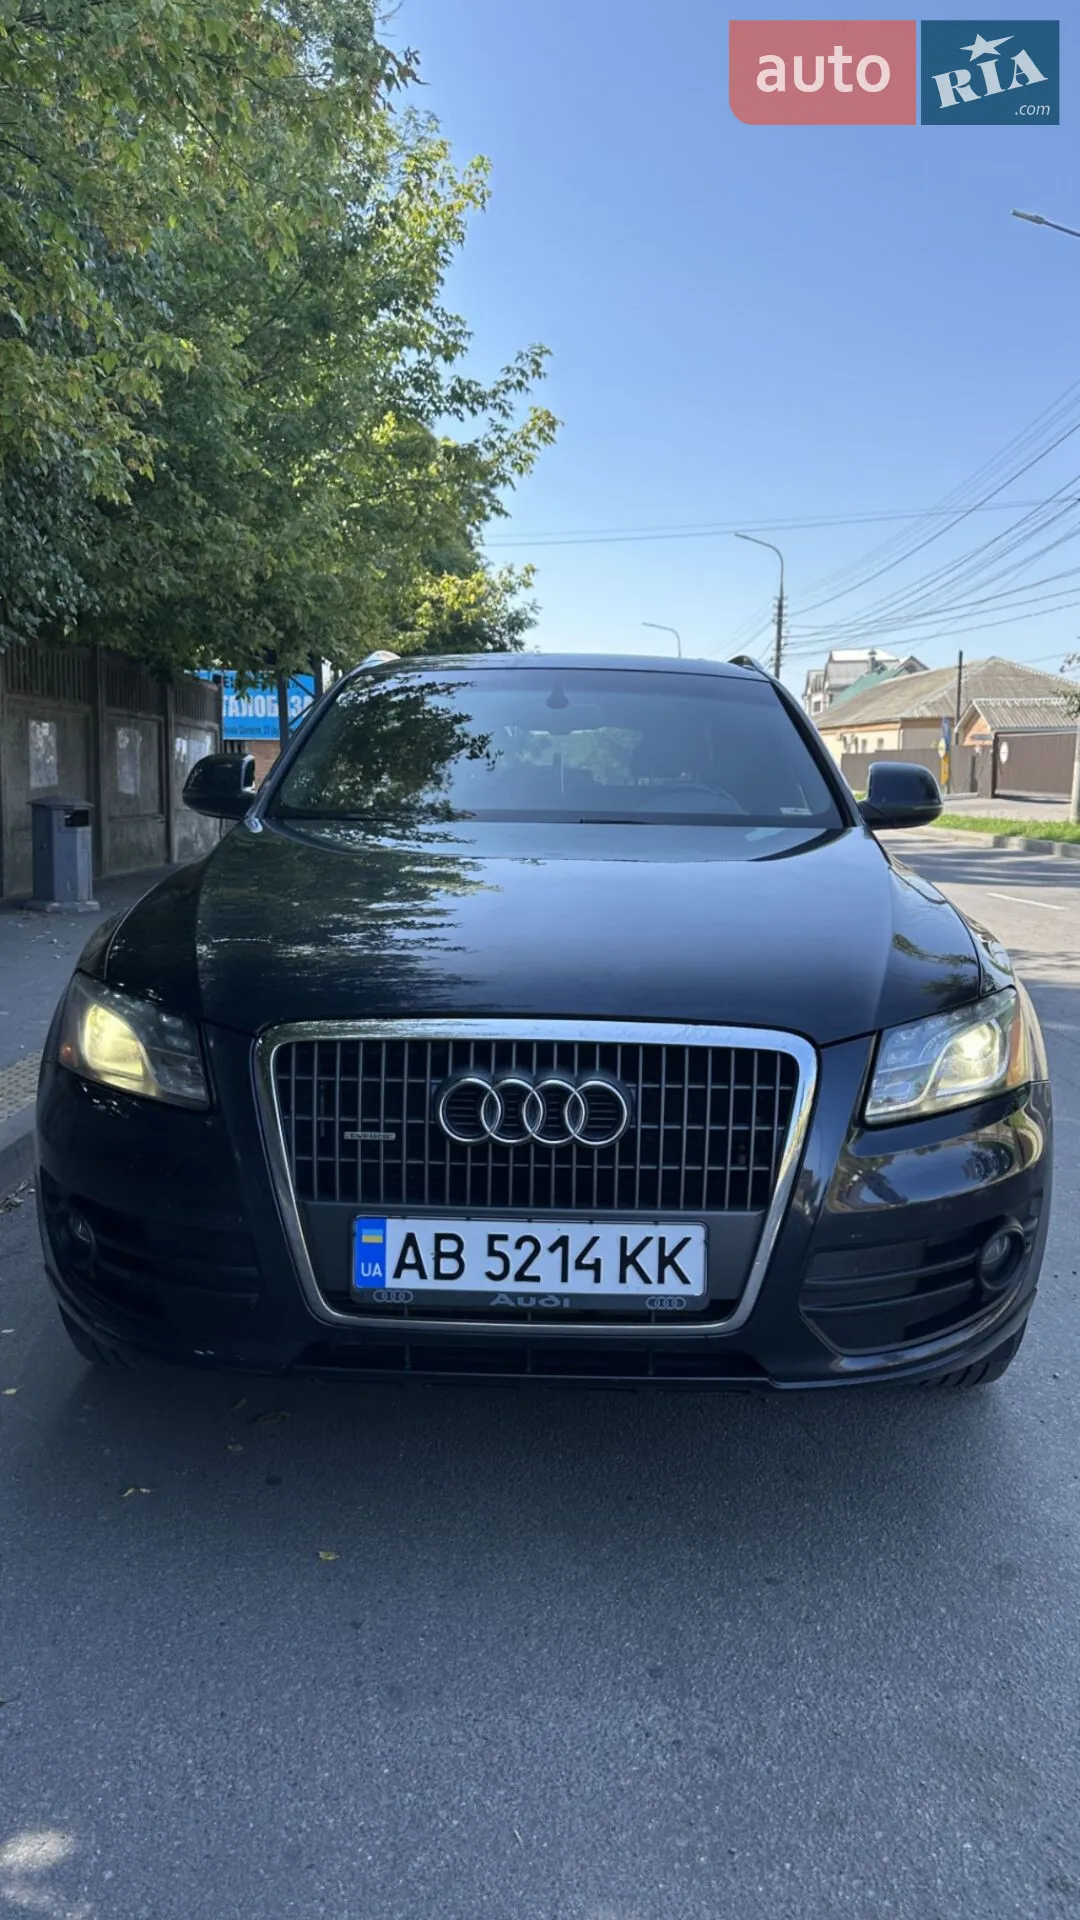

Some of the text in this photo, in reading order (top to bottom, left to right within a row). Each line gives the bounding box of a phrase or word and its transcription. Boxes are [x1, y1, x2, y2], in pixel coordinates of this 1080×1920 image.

[392, 1231, 692, 1285] AB 5214 KK
[361, 1262, 382, 1278] UA
[489, 1293, 570, 1308] Audi
